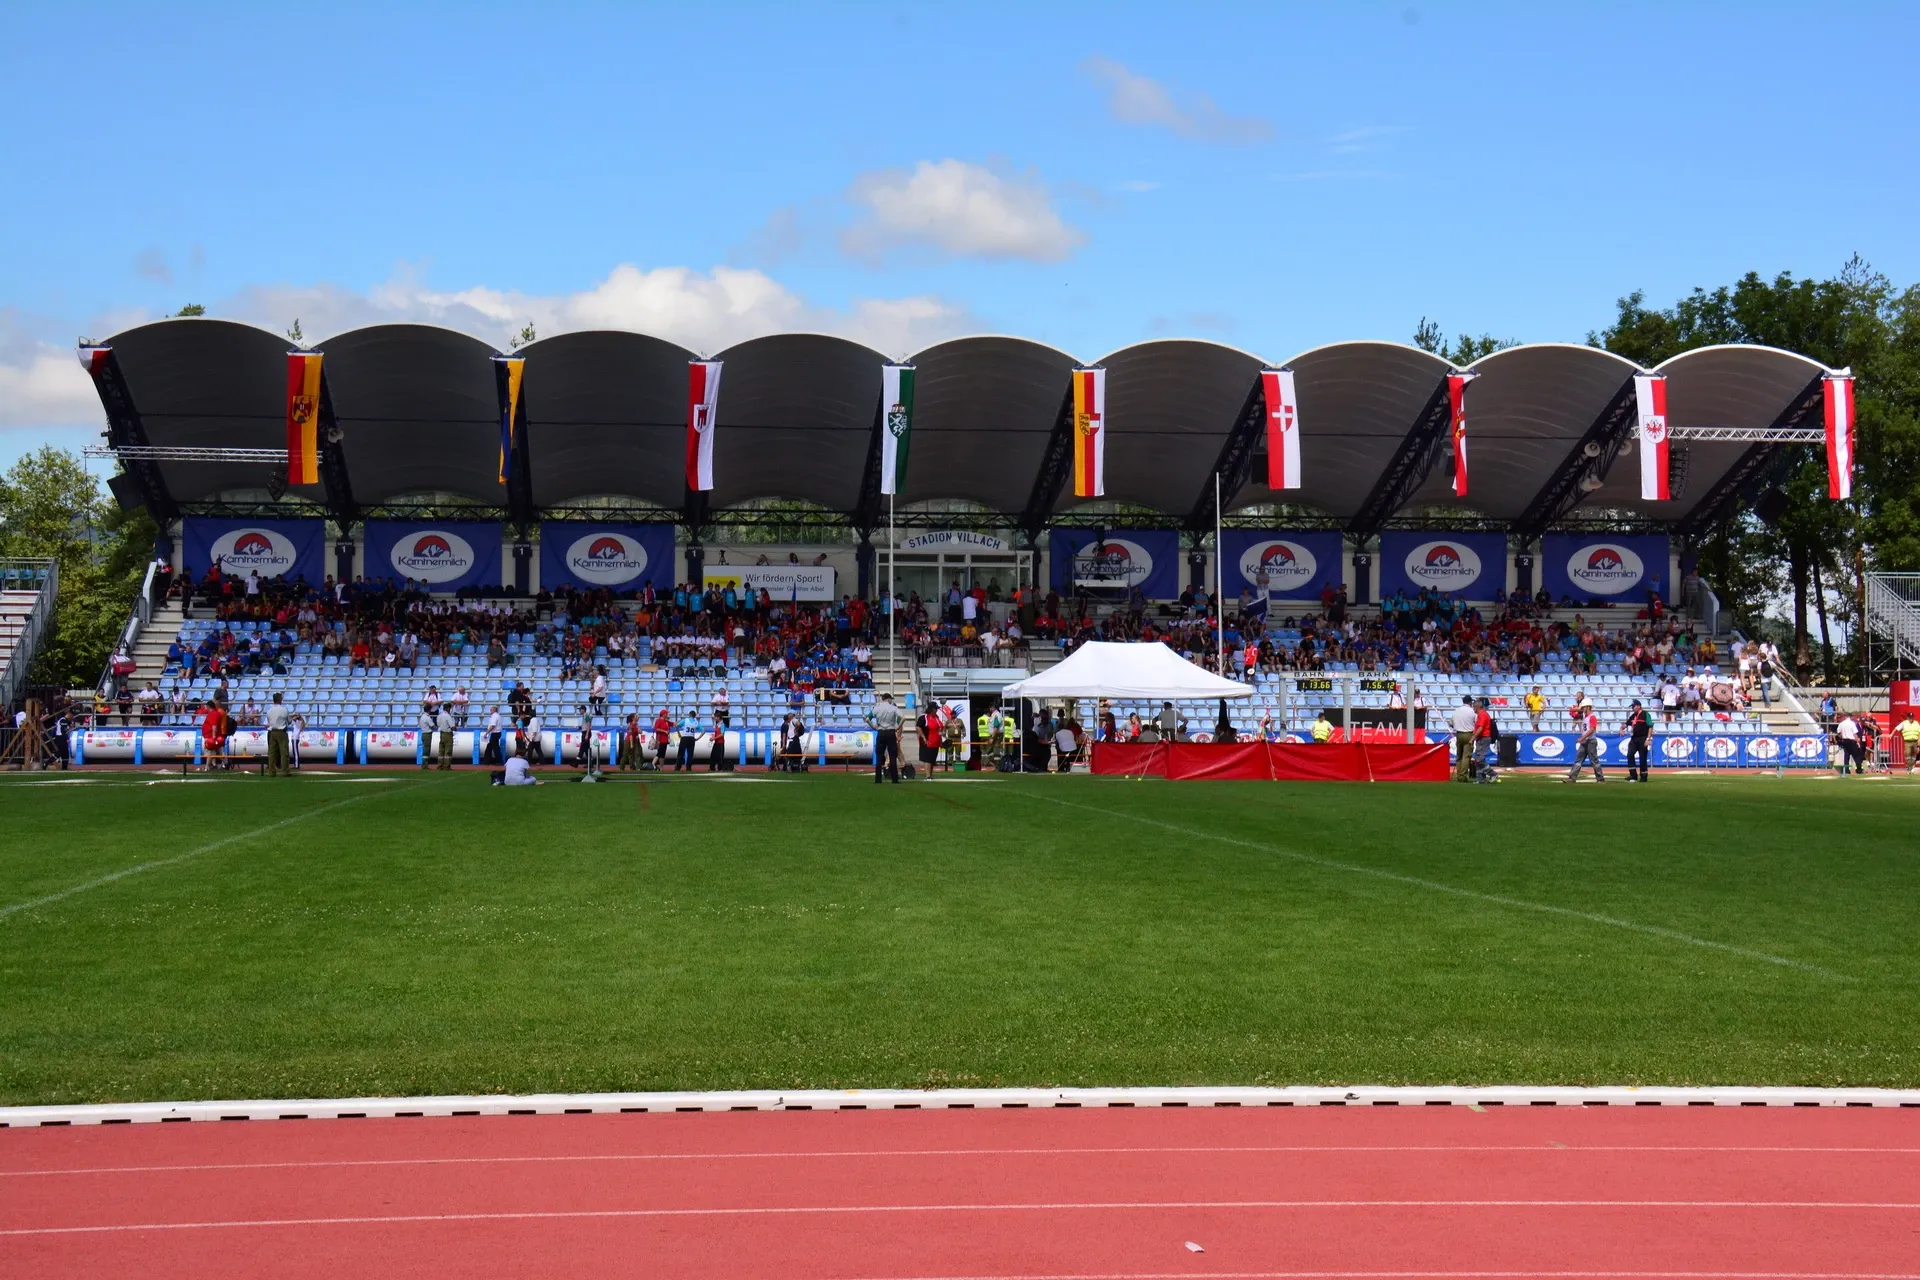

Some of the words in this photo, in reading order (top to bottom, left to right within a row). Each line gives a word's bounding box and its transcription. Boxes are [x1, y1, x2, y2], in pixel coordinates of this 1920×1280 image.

[908, 532, 952, 549] STADION
[957, 532, 1001, 550] VILLACH
[341, 545, 346, 553] 1
[519, 547, 524, 555] 1
[692, 549, 696, 557] 1
[398, 556, 467, 567] Kärntnermilch
[573, 558, 641, 568] Kärntnermilch
[1360, 556, 1367, 564] 2
[1523, 558, 1529, 566] 2
[1411, 566, 1475, 576] Kärntnermilch
[1573, 568, 1637, 578] Kärntnermilch
[746, 574, 759, 582] Wir
[763, 573, 794, 582] fördern
[796, 574, 823, 583] Sport!
[1302, 681, 1331, 689] 1.13.66
[1366, 681, 1395, 689] 1.56.12
[1349, 721, 1403, 737] TEAM
